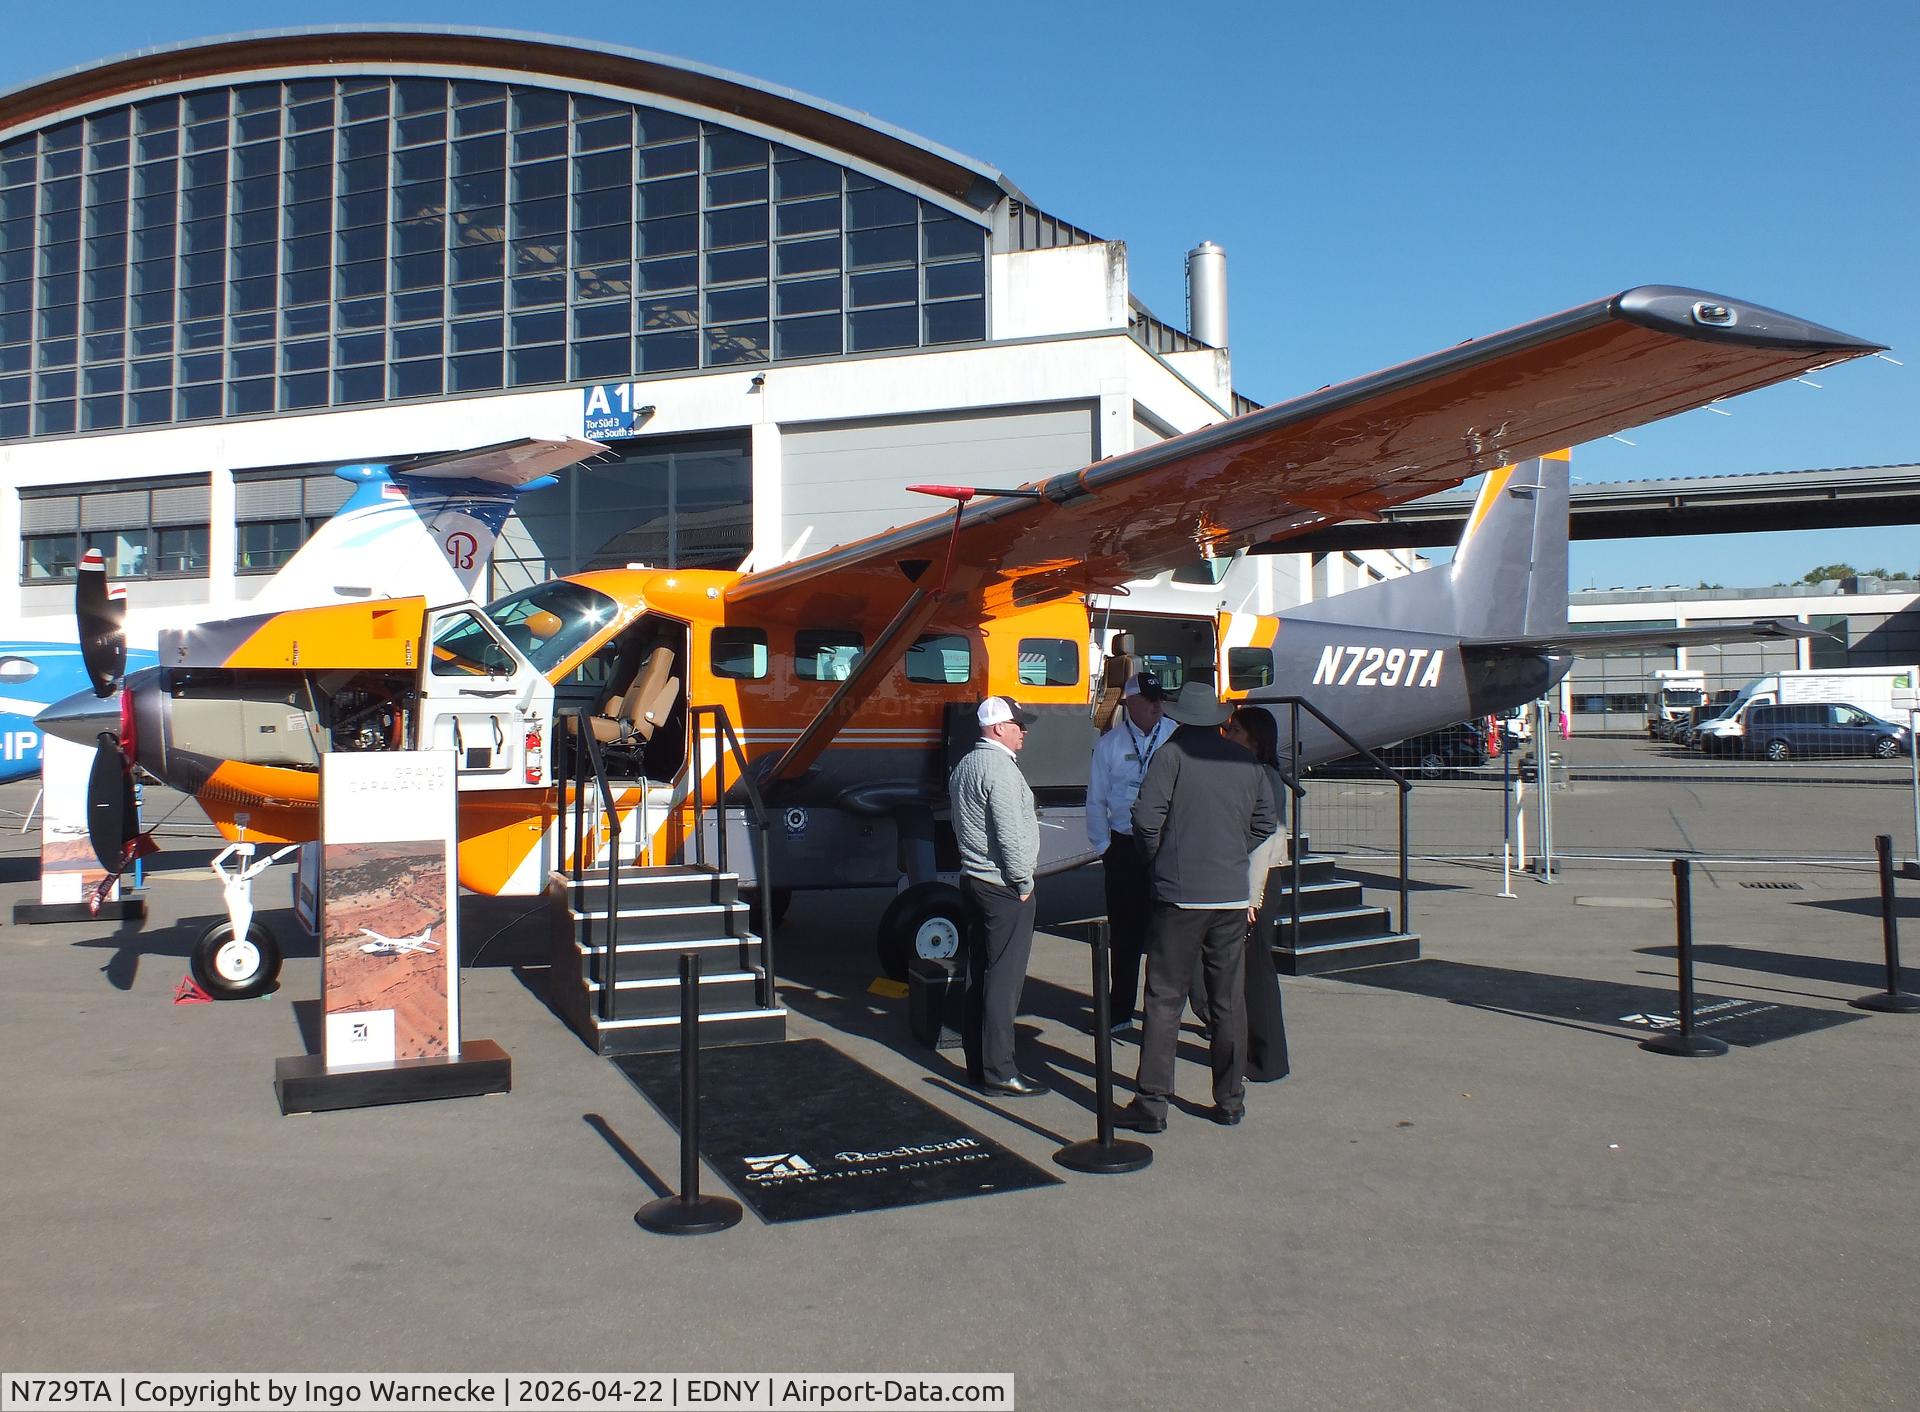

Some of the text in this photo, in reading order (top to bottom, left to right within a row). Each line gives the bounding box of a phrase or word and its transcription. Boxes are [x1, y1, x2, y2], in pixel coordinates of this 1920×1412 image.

[586, 418, 620, 429] Tor Süd 3
[586, 427, 634, 439] Gate South 3
[1312, 645, 1444, 688] N729TA
[0, 731, 43, 760] IP
[834, 1138, 980, 1162] Beechcraft
